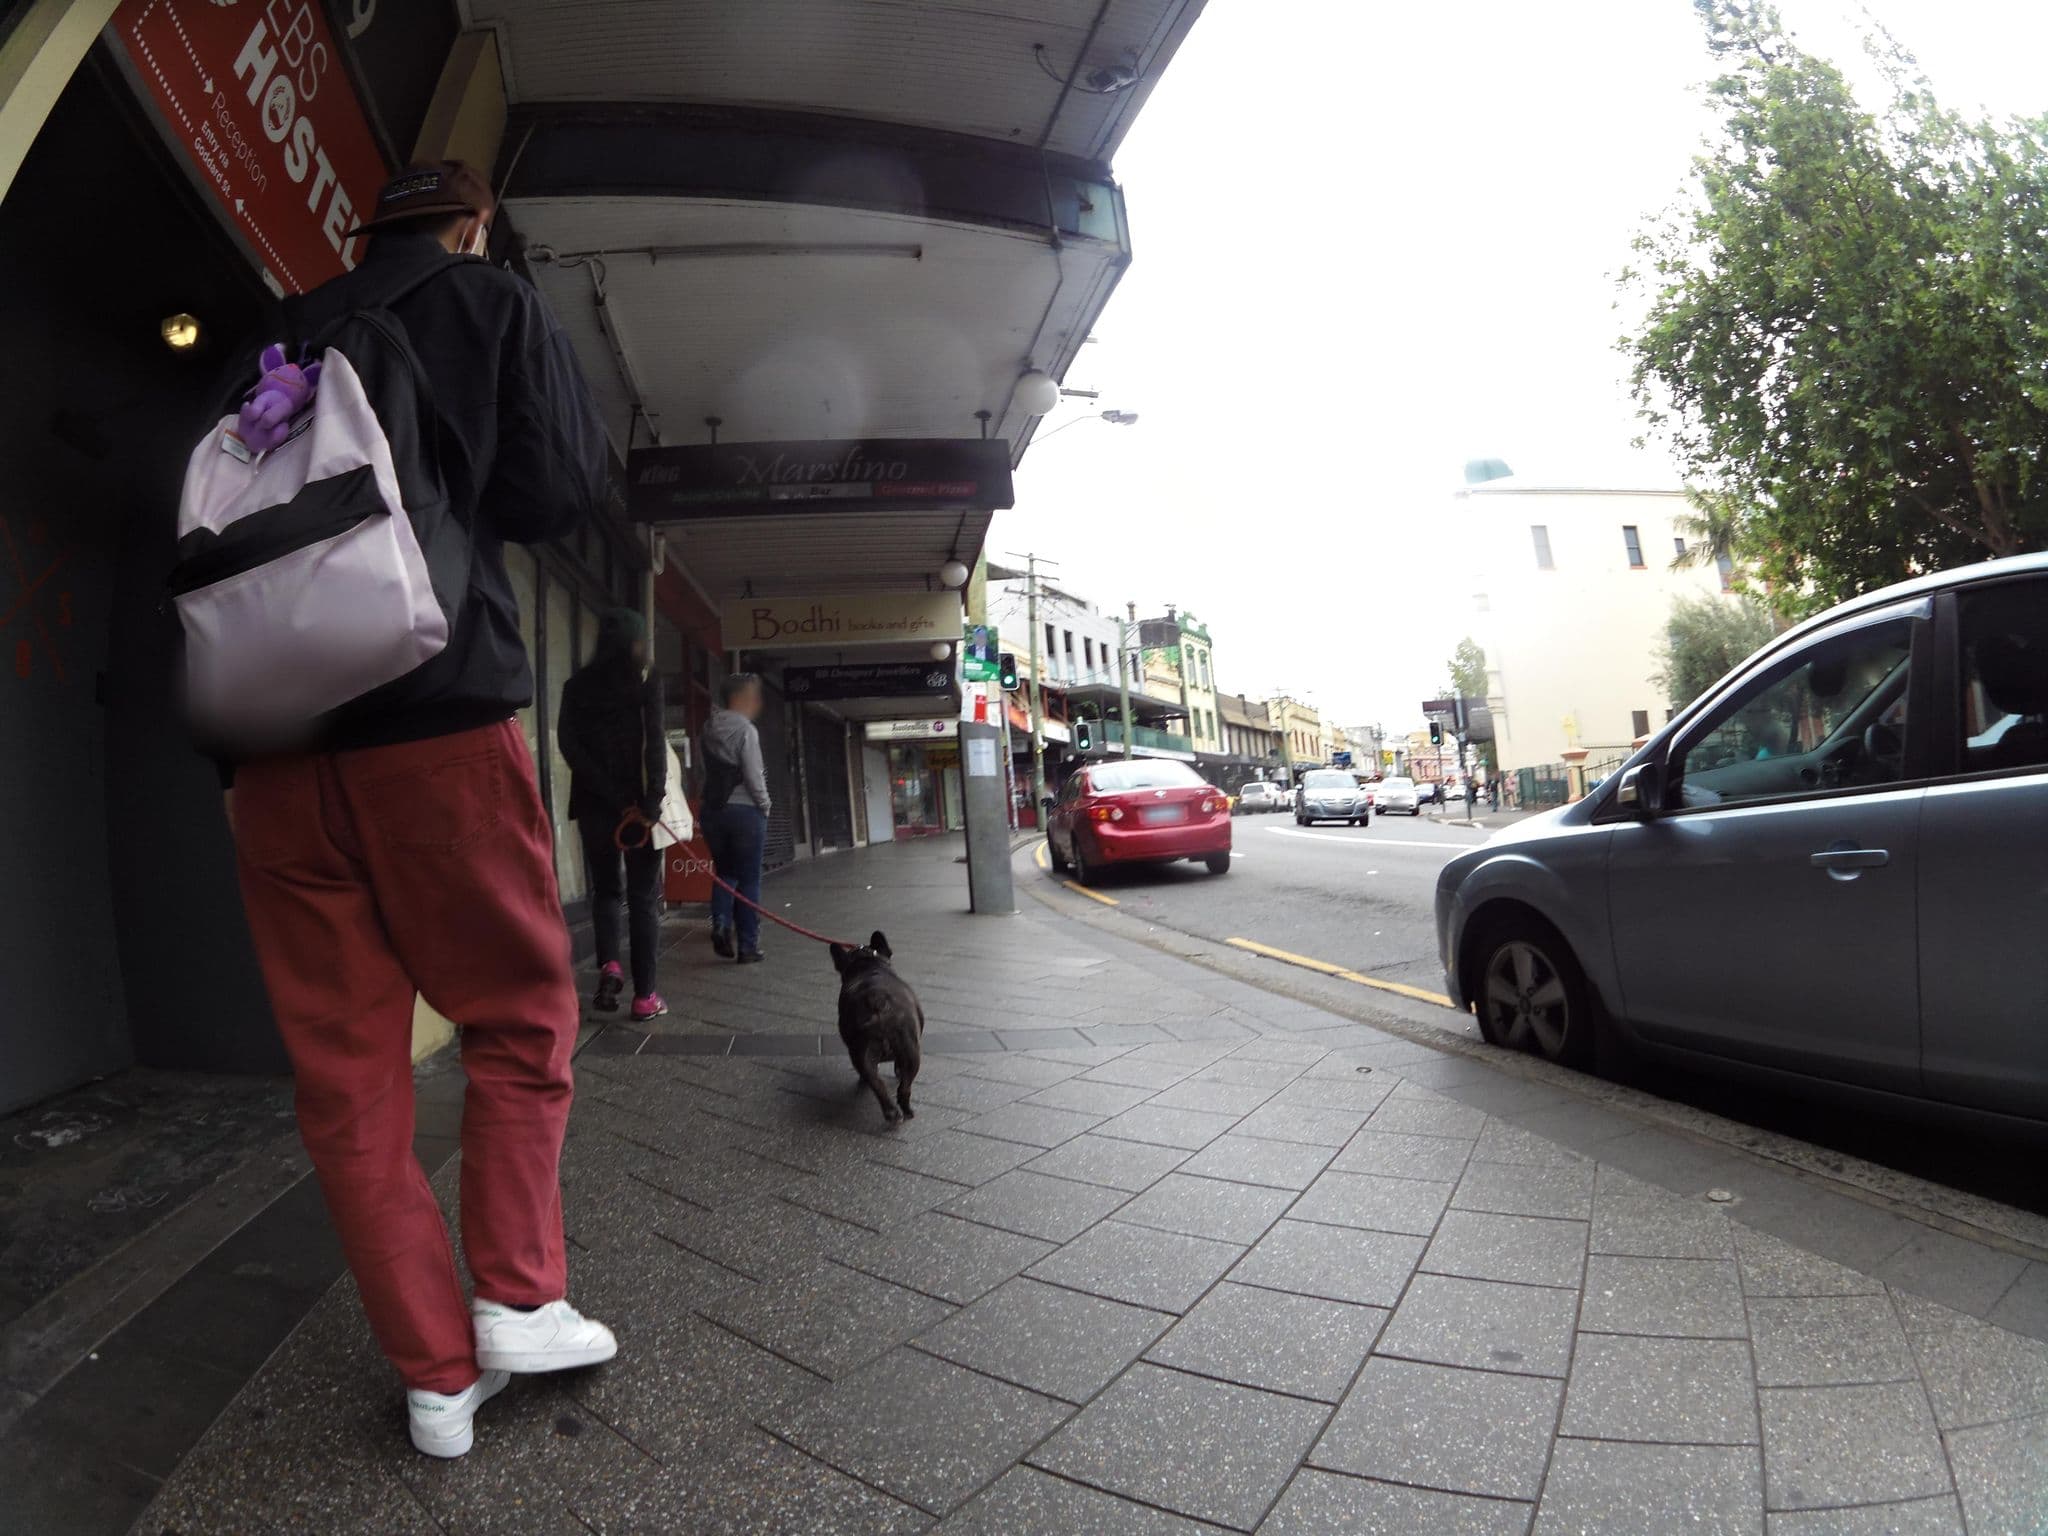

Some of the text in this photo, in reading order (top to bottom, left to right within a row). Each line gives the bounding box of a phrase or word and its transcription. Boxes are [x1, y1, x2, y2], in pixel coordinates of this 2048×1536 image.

[194, 137, 231, 198] Goddard St.
[201, 120, 229, 168] Entry via
[211, 91, 267, 192] Reception
[233, 18, 361, 272] HOSTEL
[751, 606, 935, 640] Bodhi books and gifts
